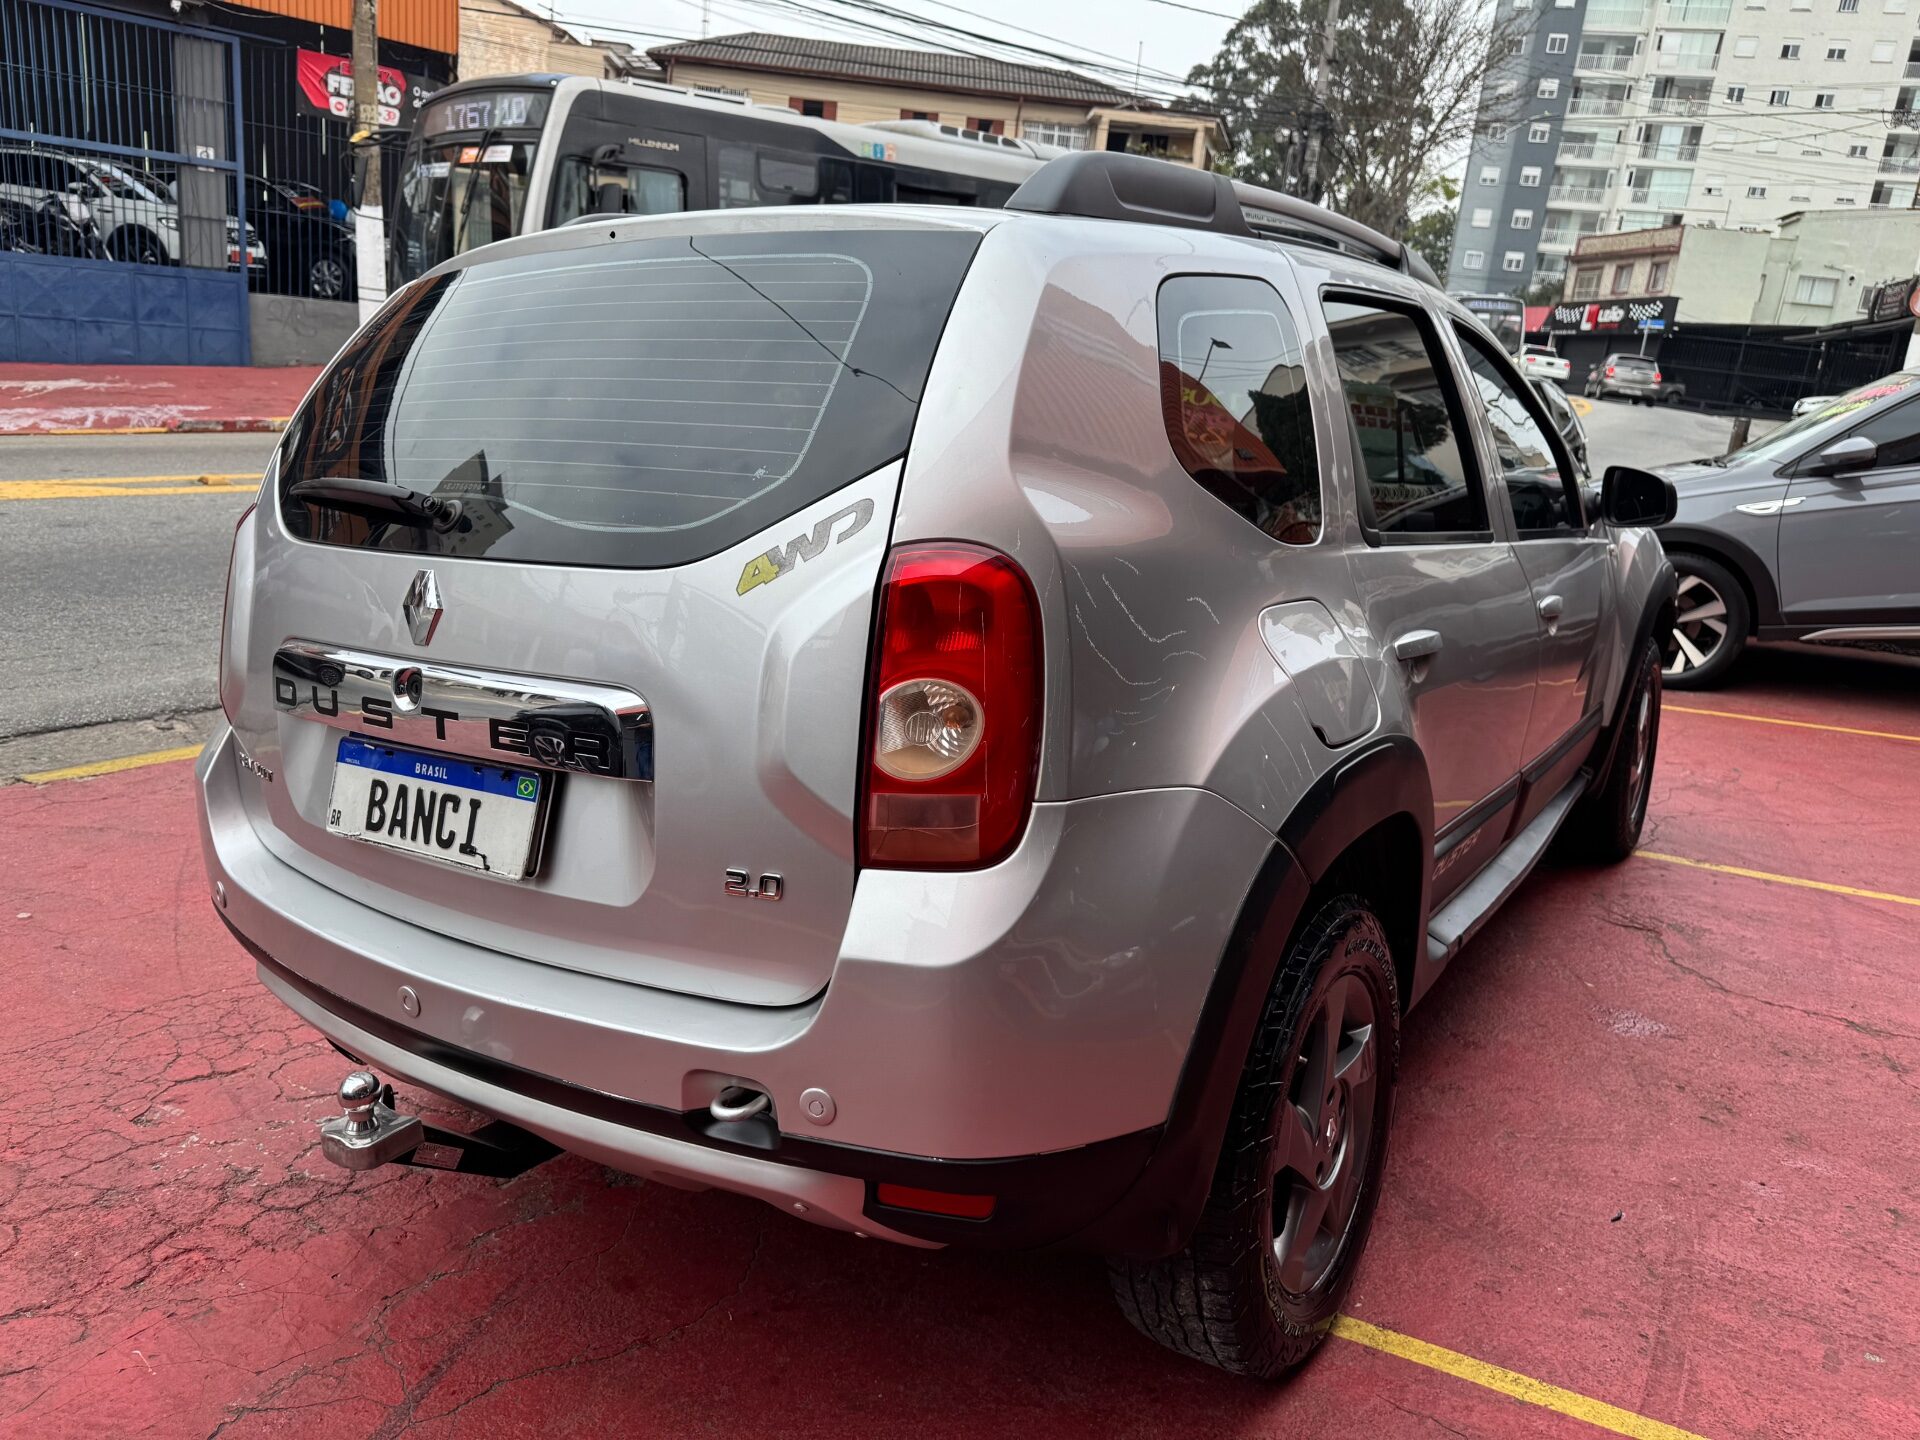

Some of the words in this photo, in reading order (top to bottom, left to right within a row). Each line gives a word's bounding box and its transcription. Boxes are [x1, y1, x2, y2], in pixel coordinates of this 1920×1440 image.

[736, 498, 874, 597] 4WD
[275, 676, 611, 770] DUSTER
[415, 762, 448, 780] BRASIL
[330, 809, 342, 827] BR
[365, 778, 482, 857] BANCI
[724, 867, 784, 901] 2.0
